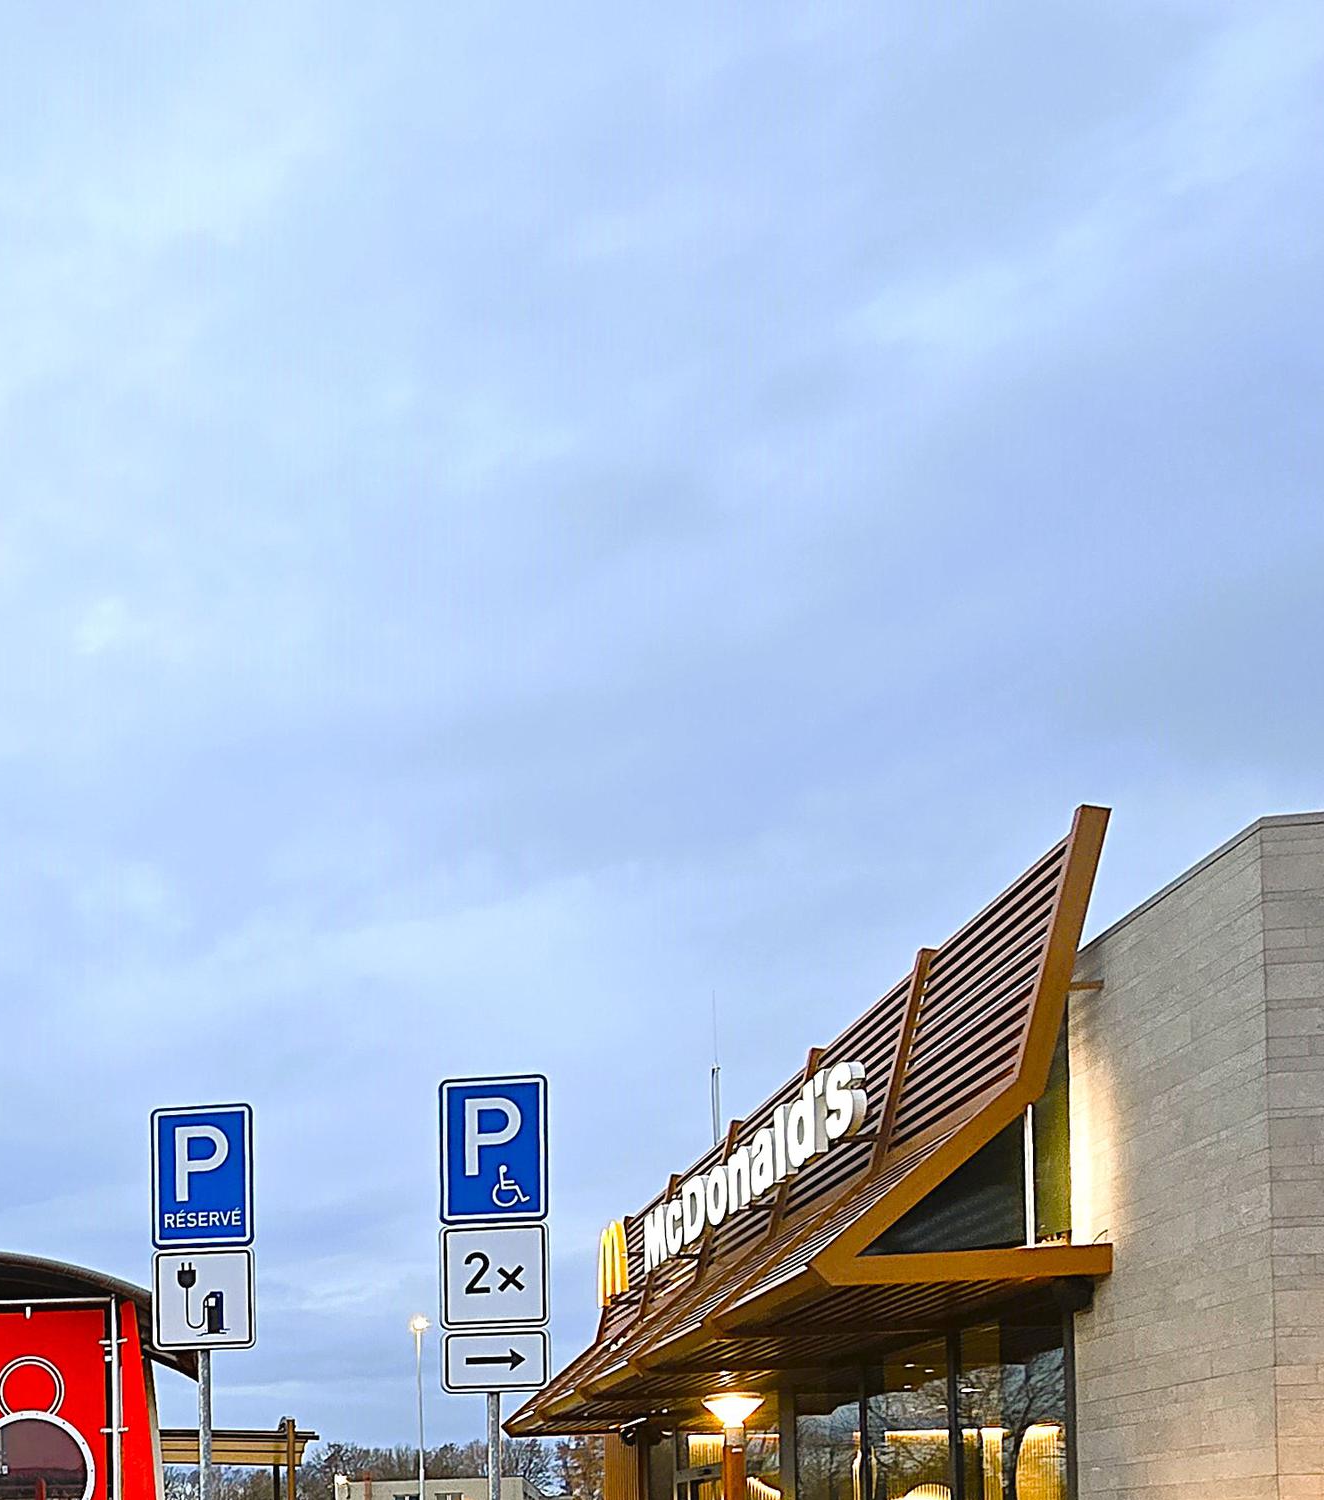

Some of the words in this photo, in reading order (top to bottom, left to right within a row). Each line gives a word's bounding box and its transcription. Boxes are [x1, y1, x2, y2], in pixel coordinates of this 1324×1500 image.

[174, 1125, 229, 1202] P
[464, 1097, 522, 1176] P
[643, 1060, 867, 1275] McDonald's
[164, 1208, 242, 1229] RÉSERVÉ
